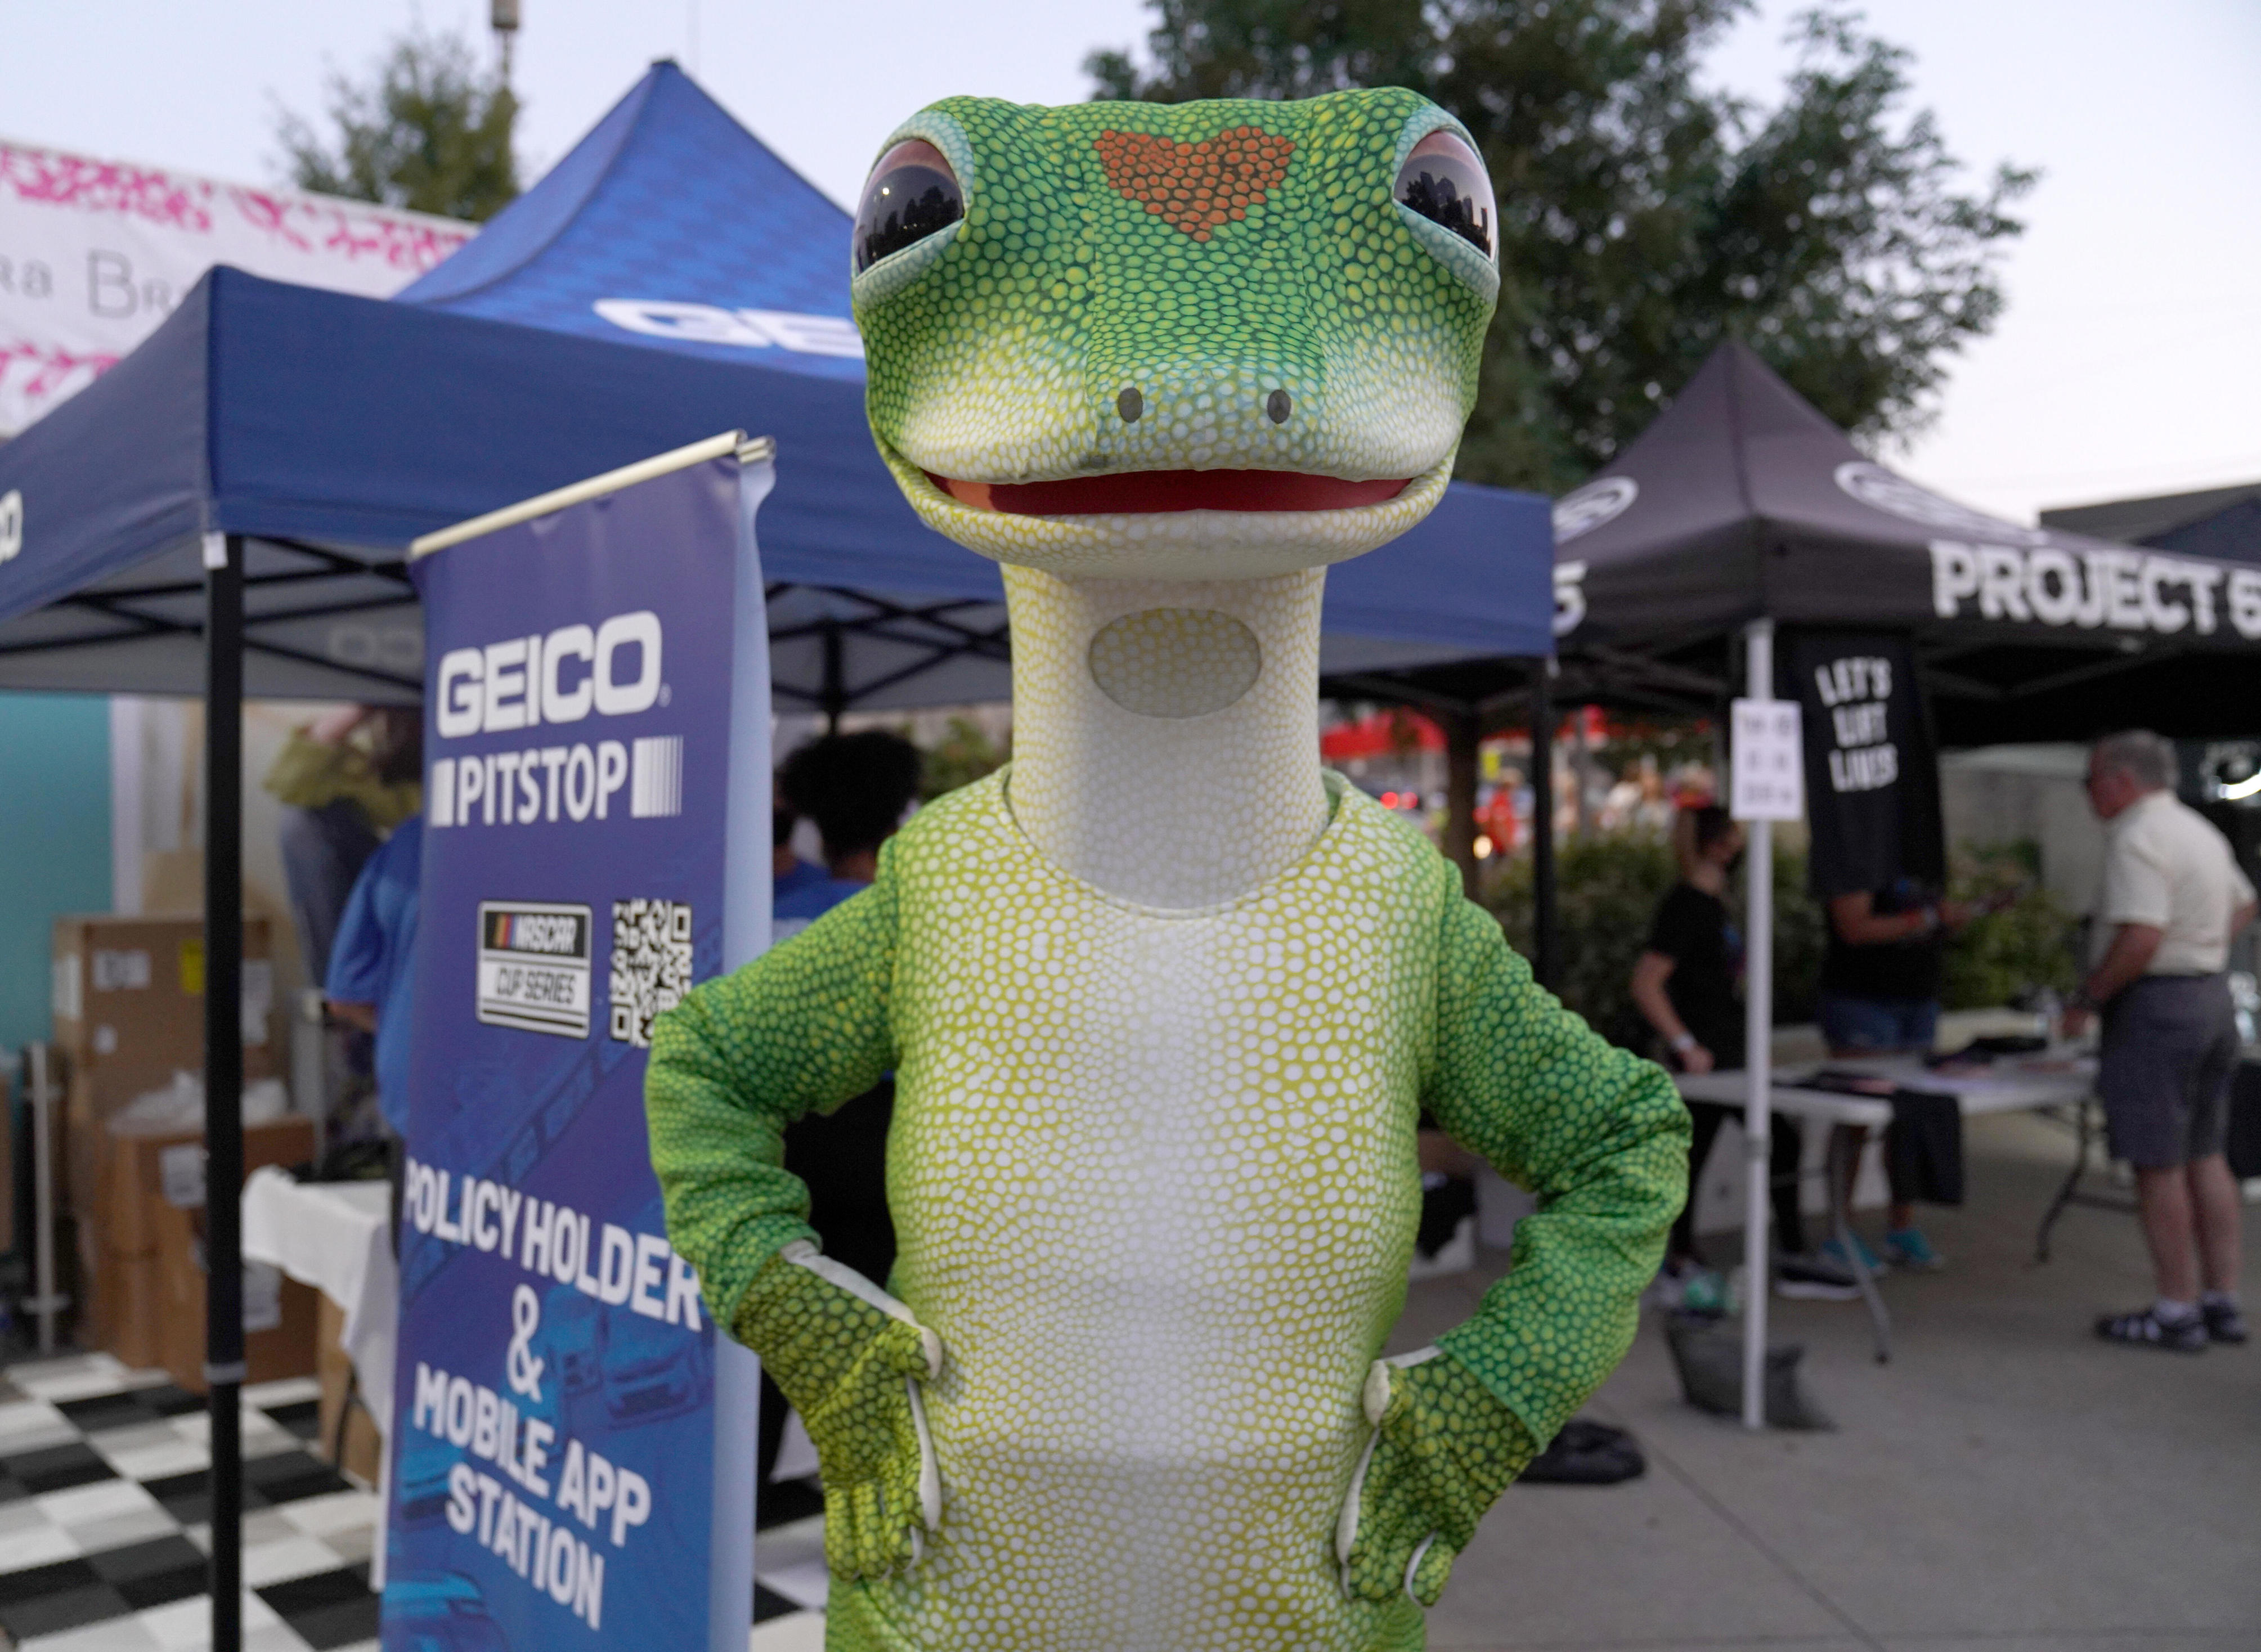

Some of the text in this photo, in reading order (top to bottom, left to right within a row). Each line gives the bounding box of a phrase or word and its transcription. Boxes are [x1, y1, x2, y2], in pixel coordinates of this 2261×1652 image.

[1930, 539, 2223, 636] PROJECT
[437, 610, 662, 738] GEICO
[457, 740, 628, 827] PITSTOP
[496, 967, 576, 1005] CUP SERIES
[514, 914, 578, 955] NASCAR
[508, 1283, 545, 1404] &
[413, 1361, 651, 1547] MOBILE APP
[446, 1462, 605, 1632] STATION
